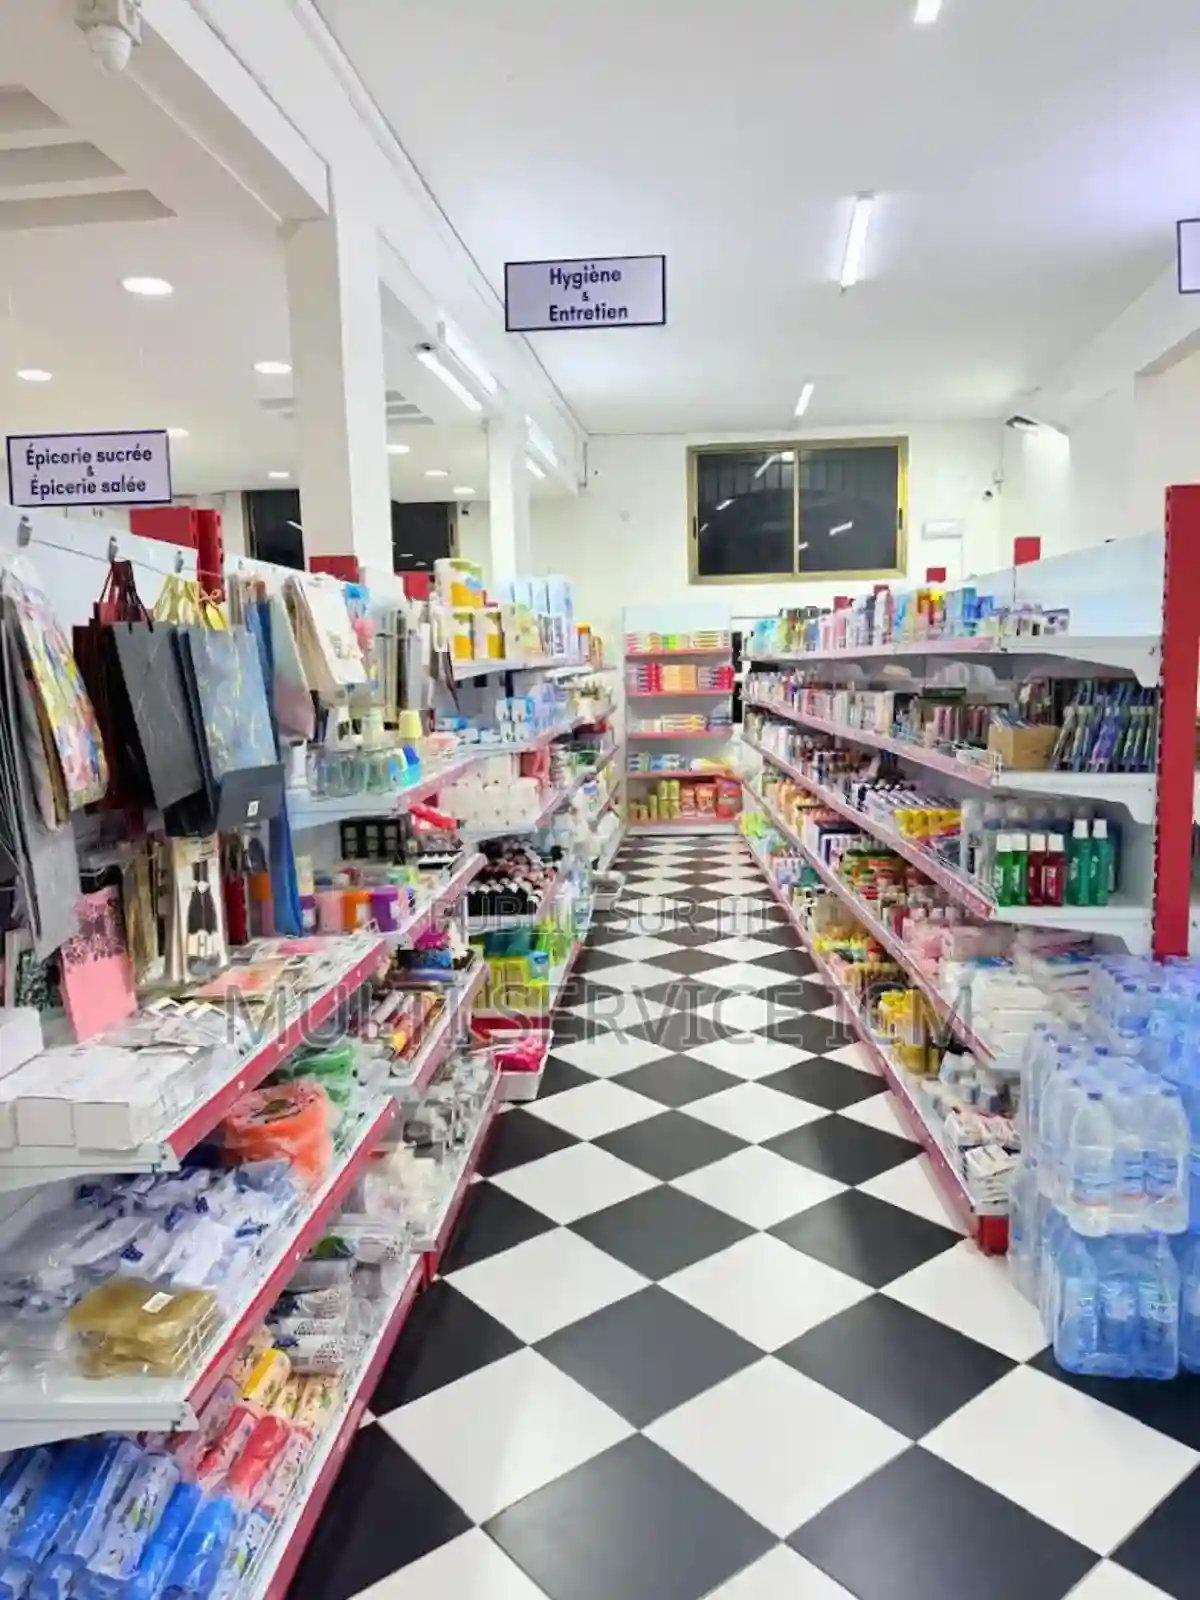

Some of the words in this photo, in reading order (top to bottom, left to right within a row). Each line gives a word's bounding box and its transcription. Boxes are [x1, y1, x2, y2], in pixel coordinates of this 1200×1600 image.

[549, 264, 622, 290] Hygiène
[581, 291, 590, 302] &
[549, 303, 629, 322] Entretien
[26, 442, 92, 470] Épicerie
[97, 440, 152, 462] sucrée
[86, 465, 95, 477] &
[30, 474, 97, 500] Épicerie
[101, 473, 147, 493] salée
